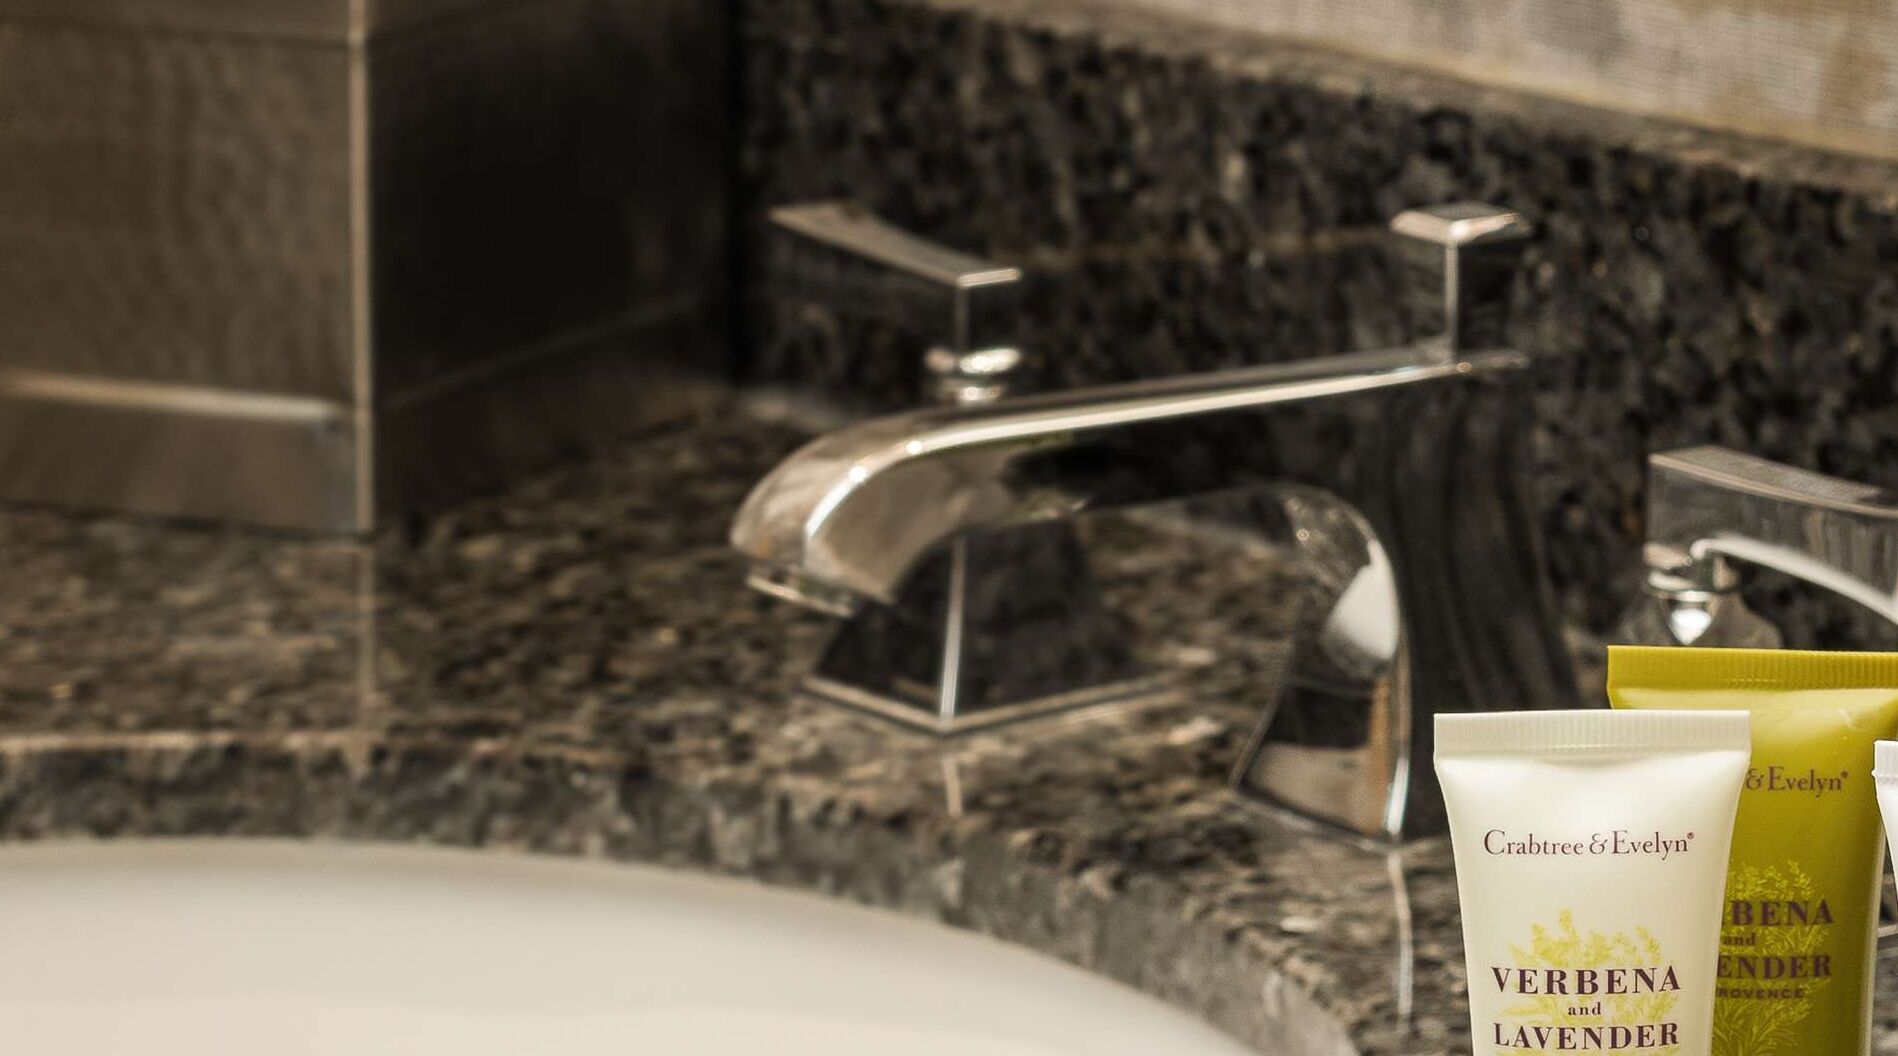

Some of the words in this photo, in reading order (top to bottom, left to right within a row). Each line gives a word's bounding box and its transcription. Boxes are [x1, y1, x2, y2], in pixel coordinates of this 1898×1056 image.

[1484, 829, 1584, 856] Crabtree
[1589, 833, 1609, 855] &
[1721, 899, 1835, 927] BENA
[1723, 932, 1756, 946] and
[1717, 955, 1833, 980] ENDER
[1491, 965, 1682, 997] VERBENA
[1718, 987, 1806, 999] ROVENCE
[1567, 1002, 1602, 1016] and
[1493, 1023, 1680, 1051] LAVENDER
